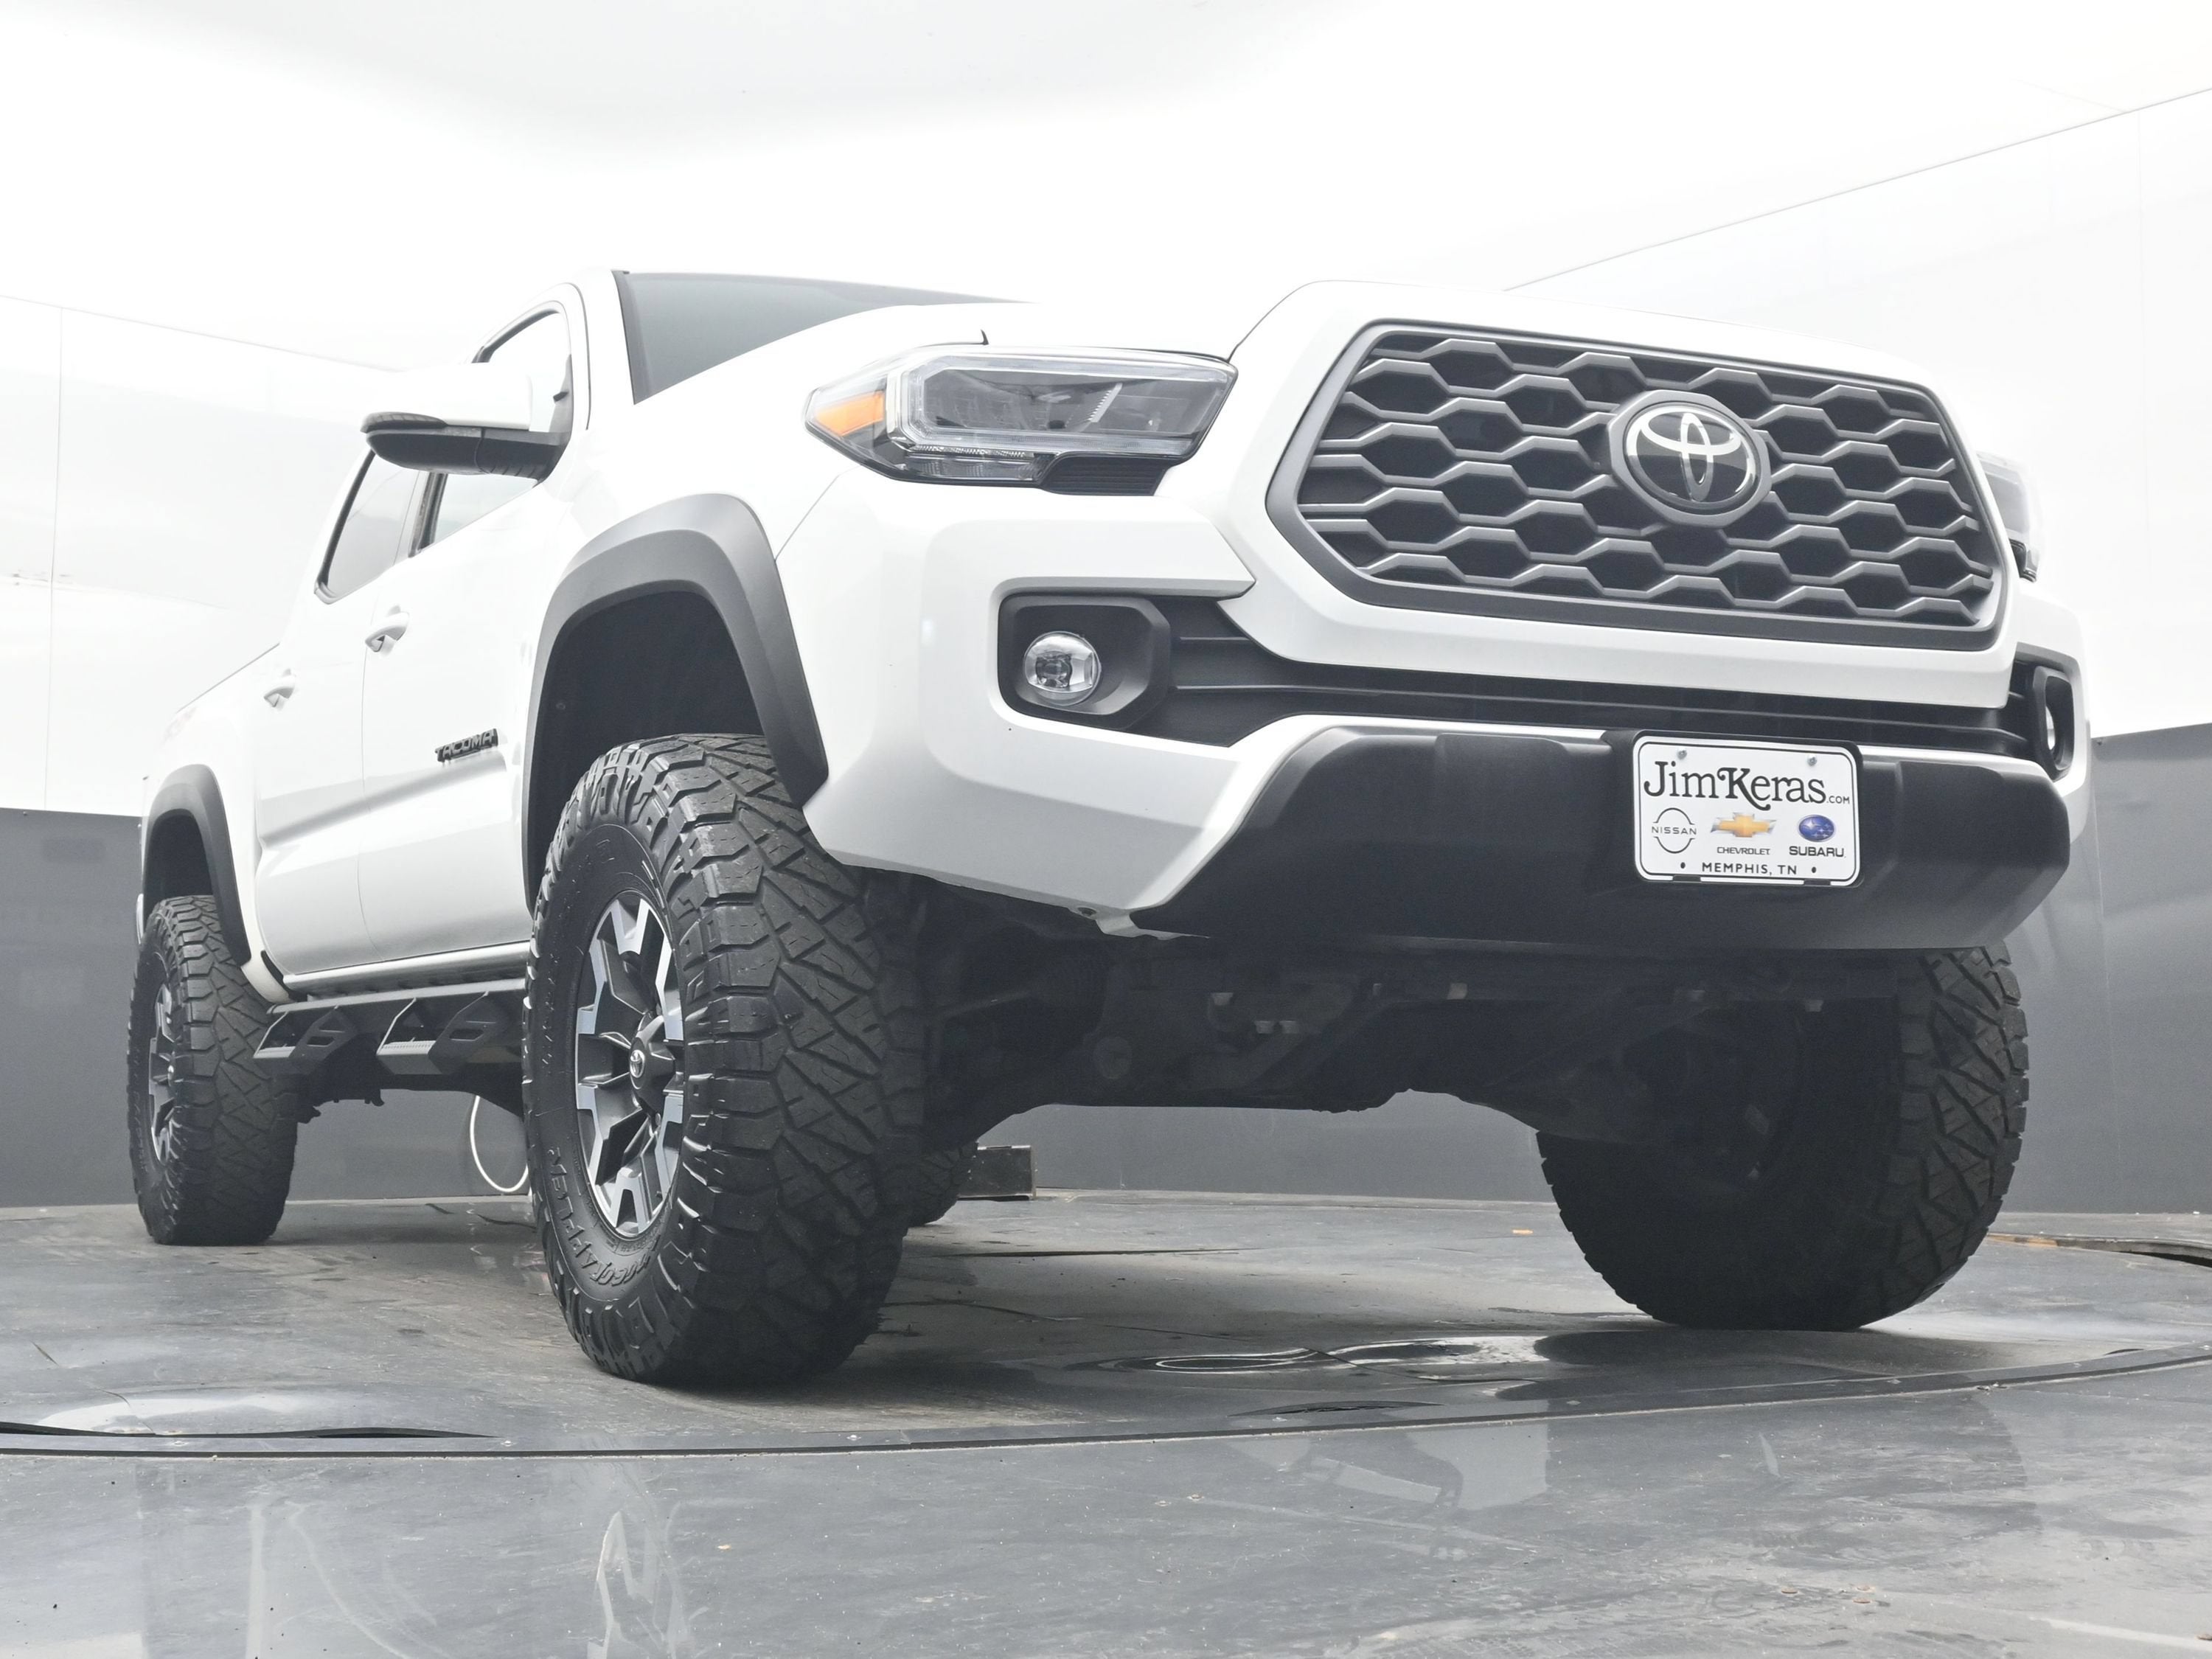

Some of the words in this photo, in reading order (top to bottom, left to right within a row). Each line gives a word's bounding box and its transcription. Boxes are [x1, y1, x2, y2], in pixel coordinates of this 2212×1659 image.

[434, 728, 498, 762] TACOMA
[1651, 826, 1697, 835] NISSAN
[1717, 846, 1770, 855] CHEVROLET
[1789, 846, 1844, 858] SUBARU
[1702, 862, 1773, 874] MEMPHIS,
[1778, 864, 1797, 874] TN
